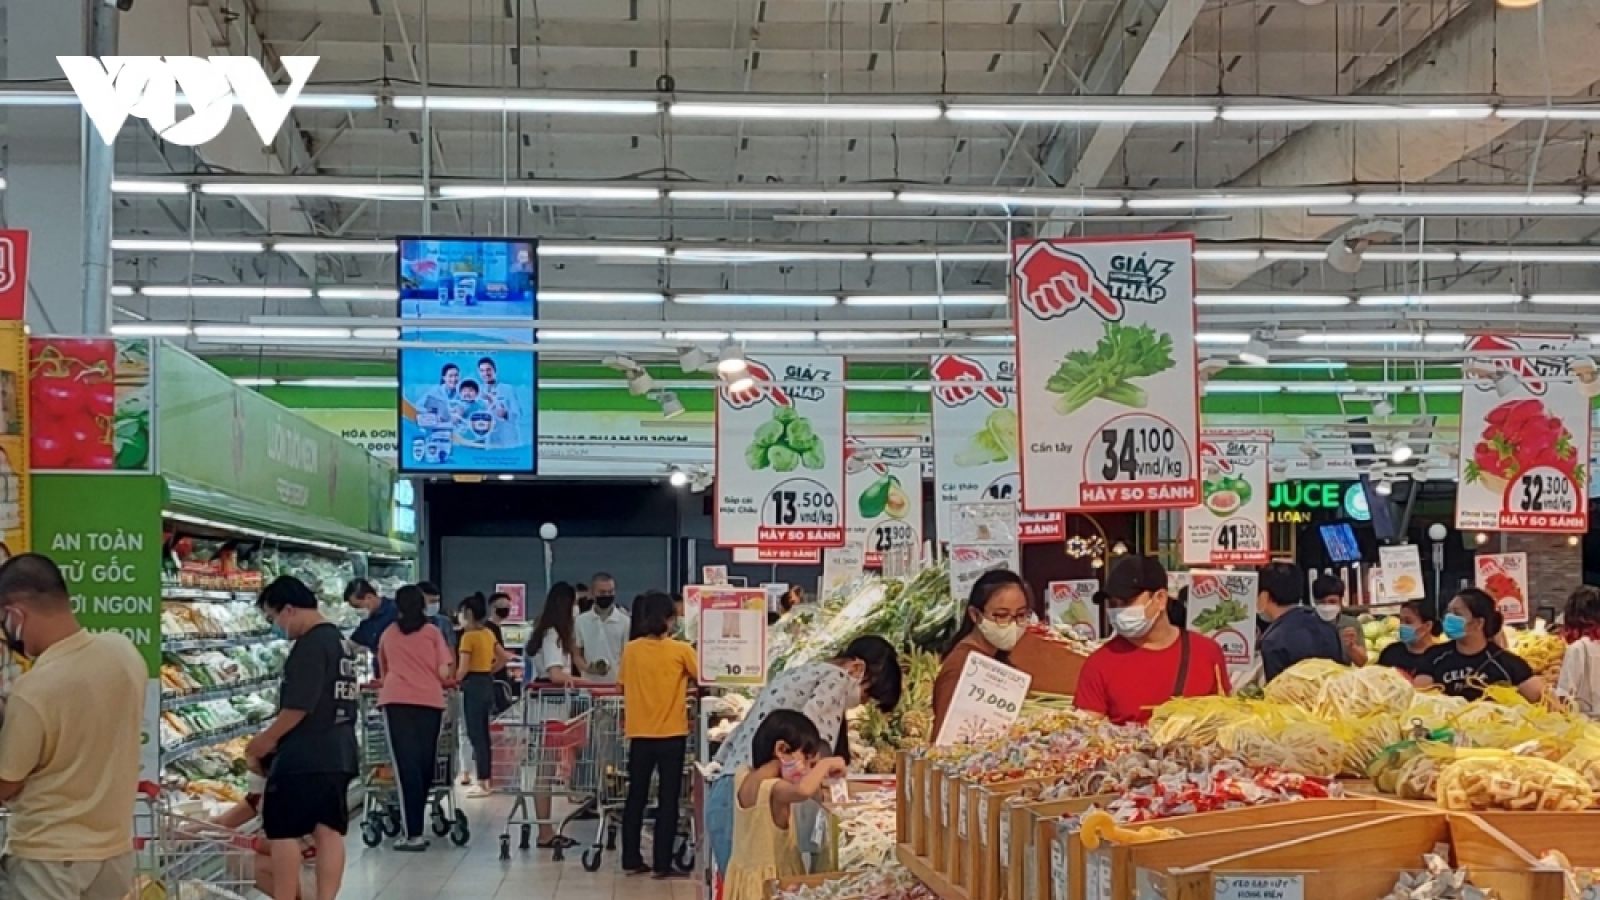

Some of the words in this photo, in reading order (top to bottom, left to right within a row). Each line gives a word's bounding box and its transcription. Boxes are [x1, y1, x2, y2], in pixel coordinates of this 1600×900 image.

[1111, 251, 1148, 273] GIÁ
[1121, 489, 1145, 500] SO
[1147, 484, 1195, 500] SÁNH
[51, 533, 81, 551] AN
[92, 555, 136, 582] GỐC
[93, 596, 153, 614] NGON
